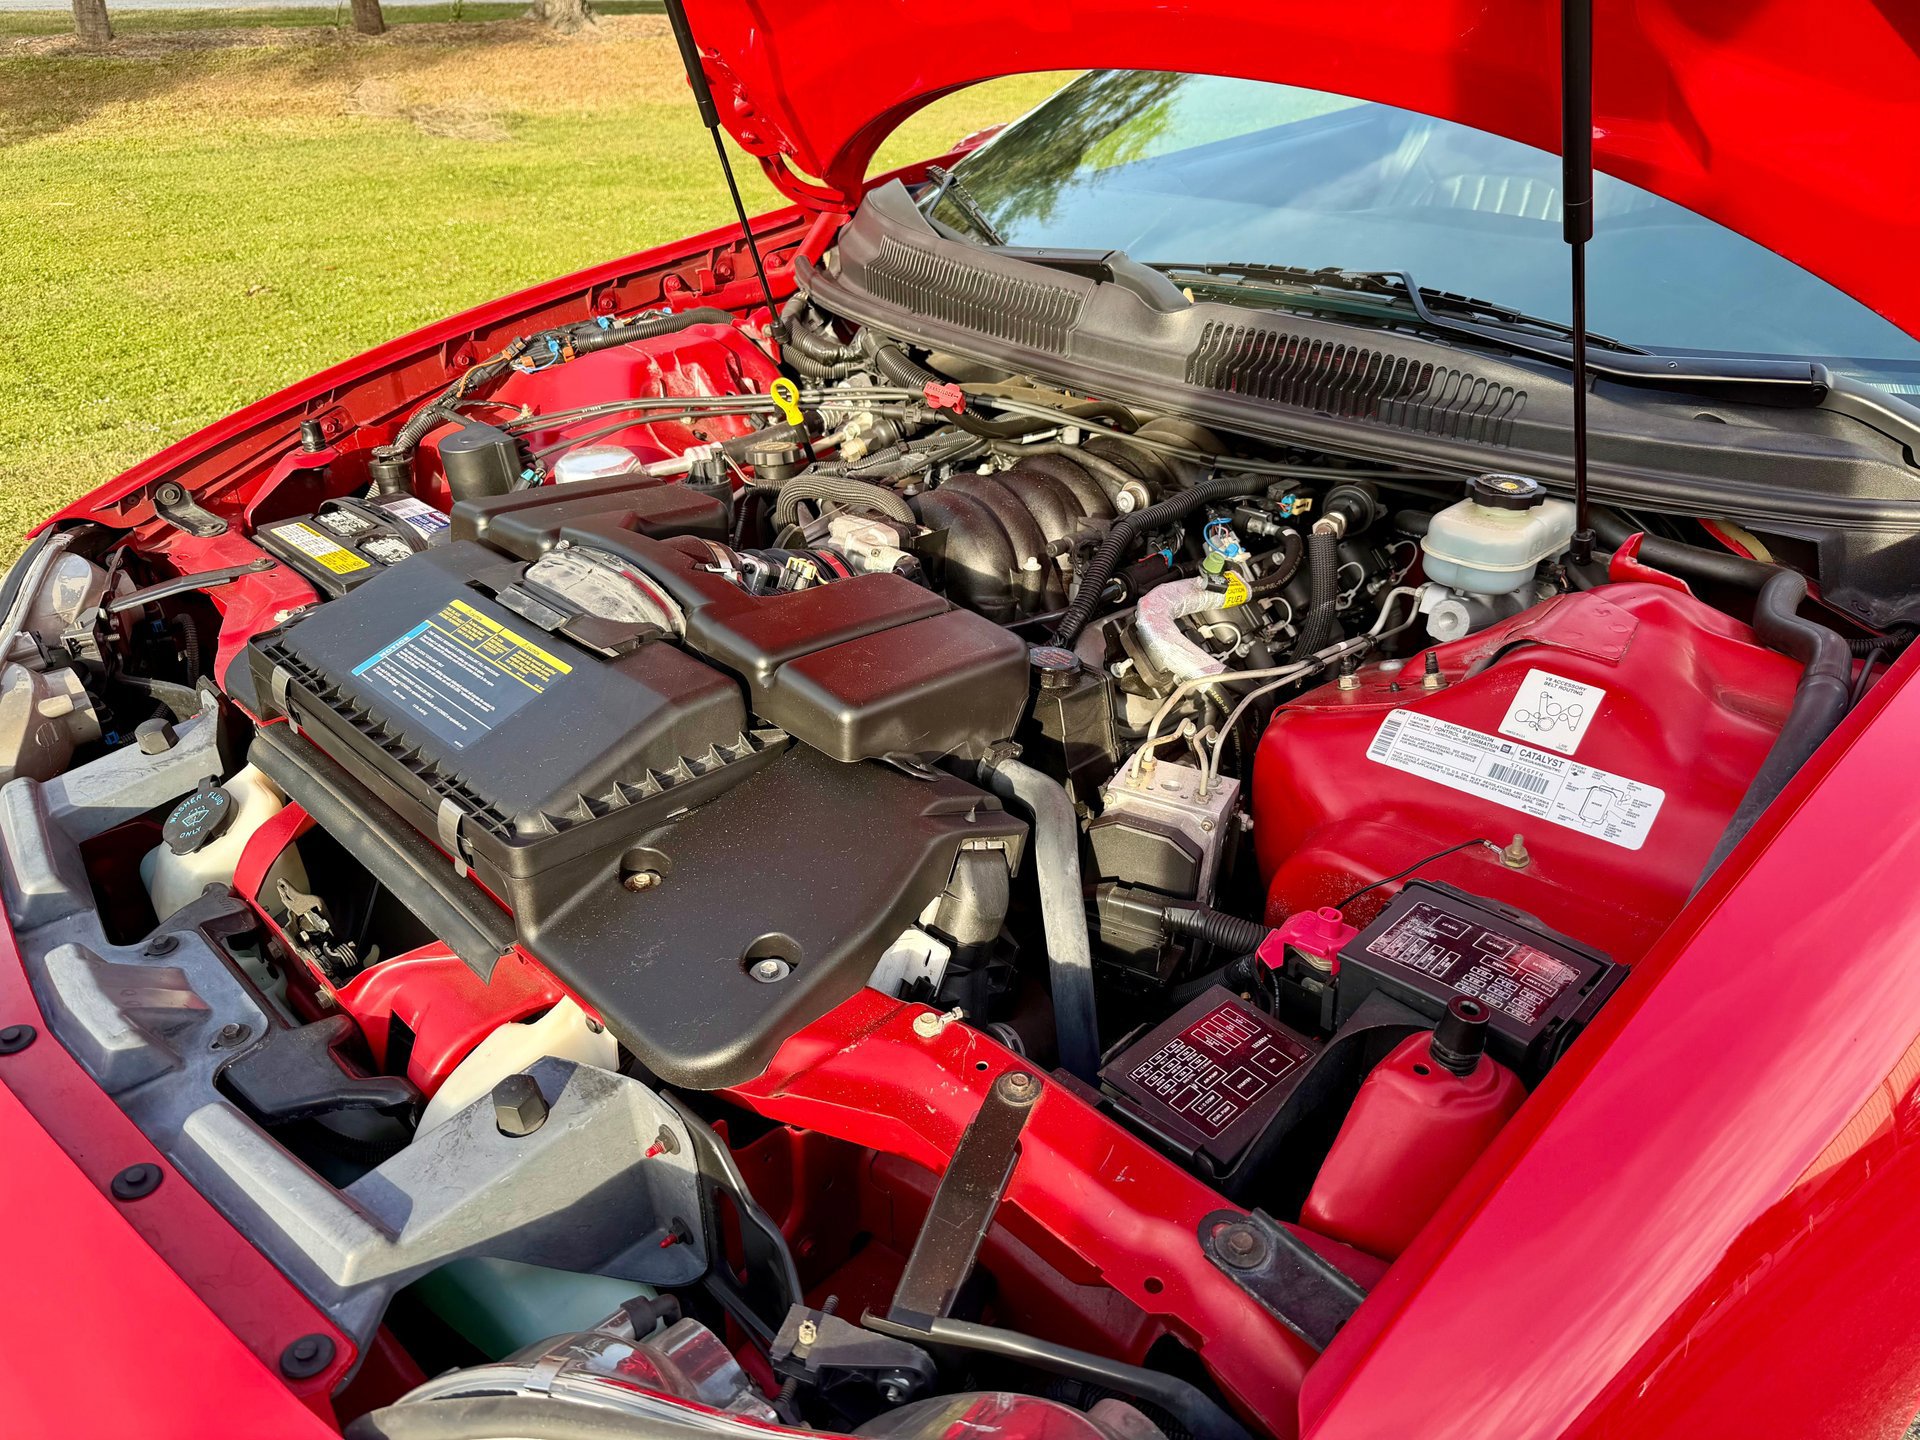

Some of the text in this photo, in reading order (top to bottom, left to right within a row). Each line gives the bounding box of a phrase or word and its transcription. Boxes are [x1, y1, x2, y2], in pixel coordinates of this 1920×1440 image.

[1228, 596, 1242, 604] FUEL
[380, 636, 410, 657] NOTICE
[1543, 680, 1583, 696] BELT ROUTING
[1552, 678, 1587, 692] ACCESSORY
[1432, 726, 1500, 750] CONTROL INFORMATION
[1442, 723, 1467, 734] VEHICLE
[1466, 730, 1494, 742] EMISSION
[1408, 735, 1435, 746] ADJUSTMENTS
[1460, 751, 1477, 759] SERVICE
[1434, 731, 1496, 753] GENERAL MOTORS CORPORATION
[1425, 744, 1454, 755] MAINTENANCE
[1453, 753, 1475, 762] SCHEDULE
[1518, 748, 1565, 768] CATALYST
[1391, 753, 1416, 763] REGULATIONS
[1416, 761, 1439, 771] APPLICABLE
[1497, 789, 1521, 799] PASSENGER
[1402, 753, 1420, 761] VEHICLE
[1420, 759, 1443, 769] CONFORMS
[1482, 780, 1512, 792] REGULATIONS
[1523, 793, 1550, 805] CALIFORNIA
[170, 792, 224, 824] WASHER FLUID
[180, 826, 202, 838] ONLY
[1491, 960, 1508, 970] HORN
[1524, 977, 1553, 992] FOG LAMP
[1208, 1070, 1219, 1079] PUMP
[1236, 1076, 1252, 1090] STARTER
[1196, 1094, 1216, 1110] A/C COMP
[1211, 1105, 1232, 1122] FUEL PUMP
